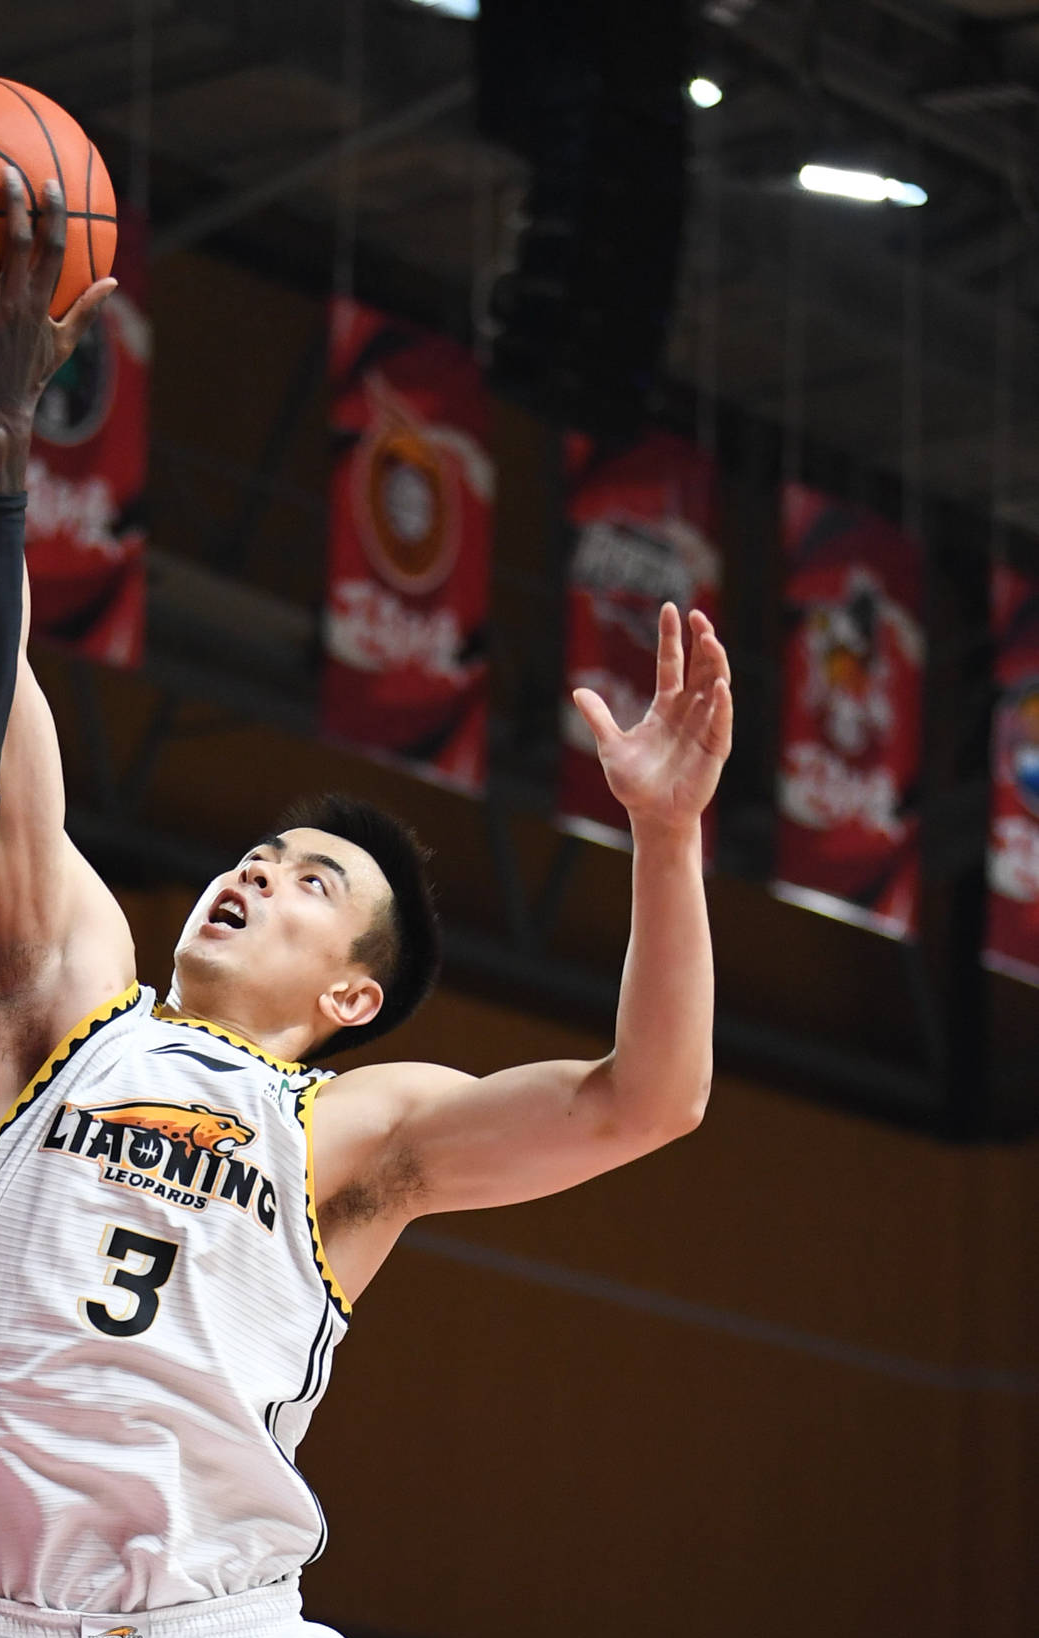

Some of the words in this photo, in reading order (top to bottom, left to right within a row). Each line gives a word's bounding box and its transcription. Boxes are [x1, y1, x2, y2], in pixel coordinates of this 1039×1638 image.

[42, 1104, 278, 1233] LIAONING
[103, 1166, 209, 1210] LEOPARDS
[78, 1224, 179, 1337] 3
